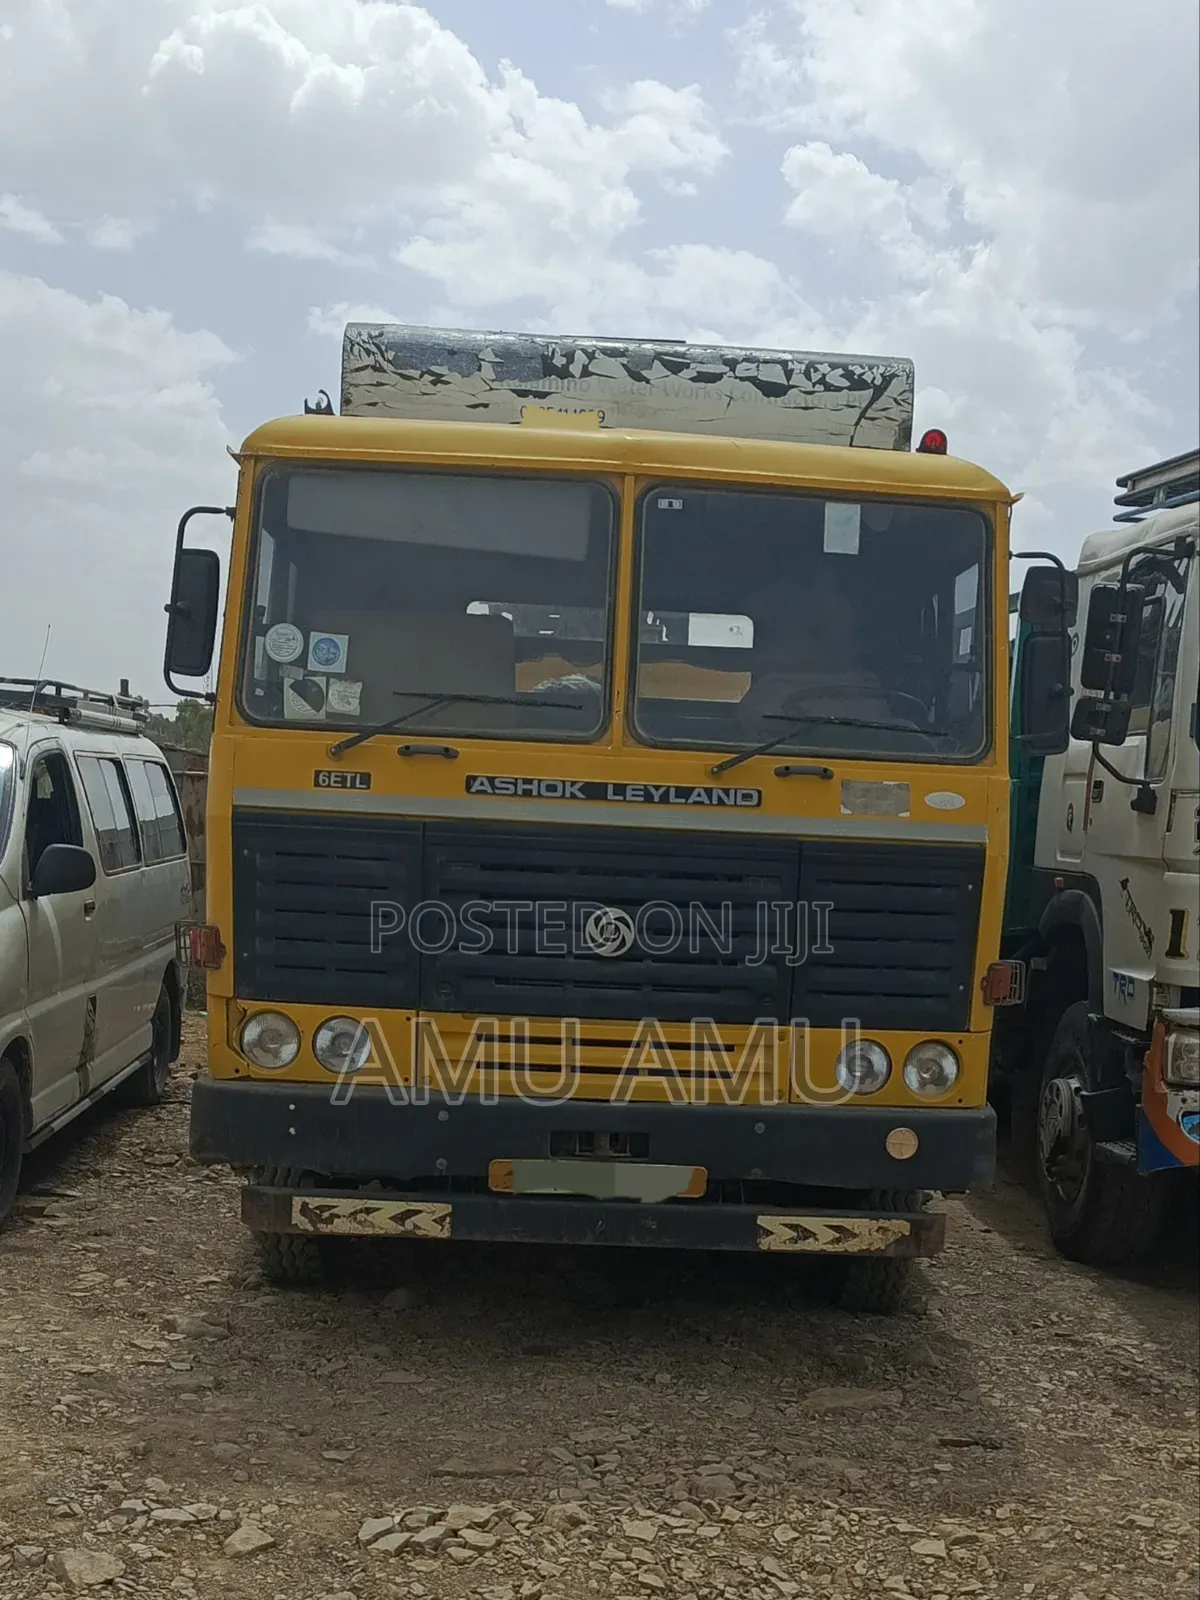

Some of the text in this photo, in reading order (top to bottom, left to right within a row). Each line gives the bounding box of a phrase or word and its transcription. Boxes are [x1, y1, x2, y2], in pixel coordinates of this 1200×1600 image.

[318, 771, 367, 789] 6ETL
[469, 776, 759, 806] ASHOK LEYLAND
